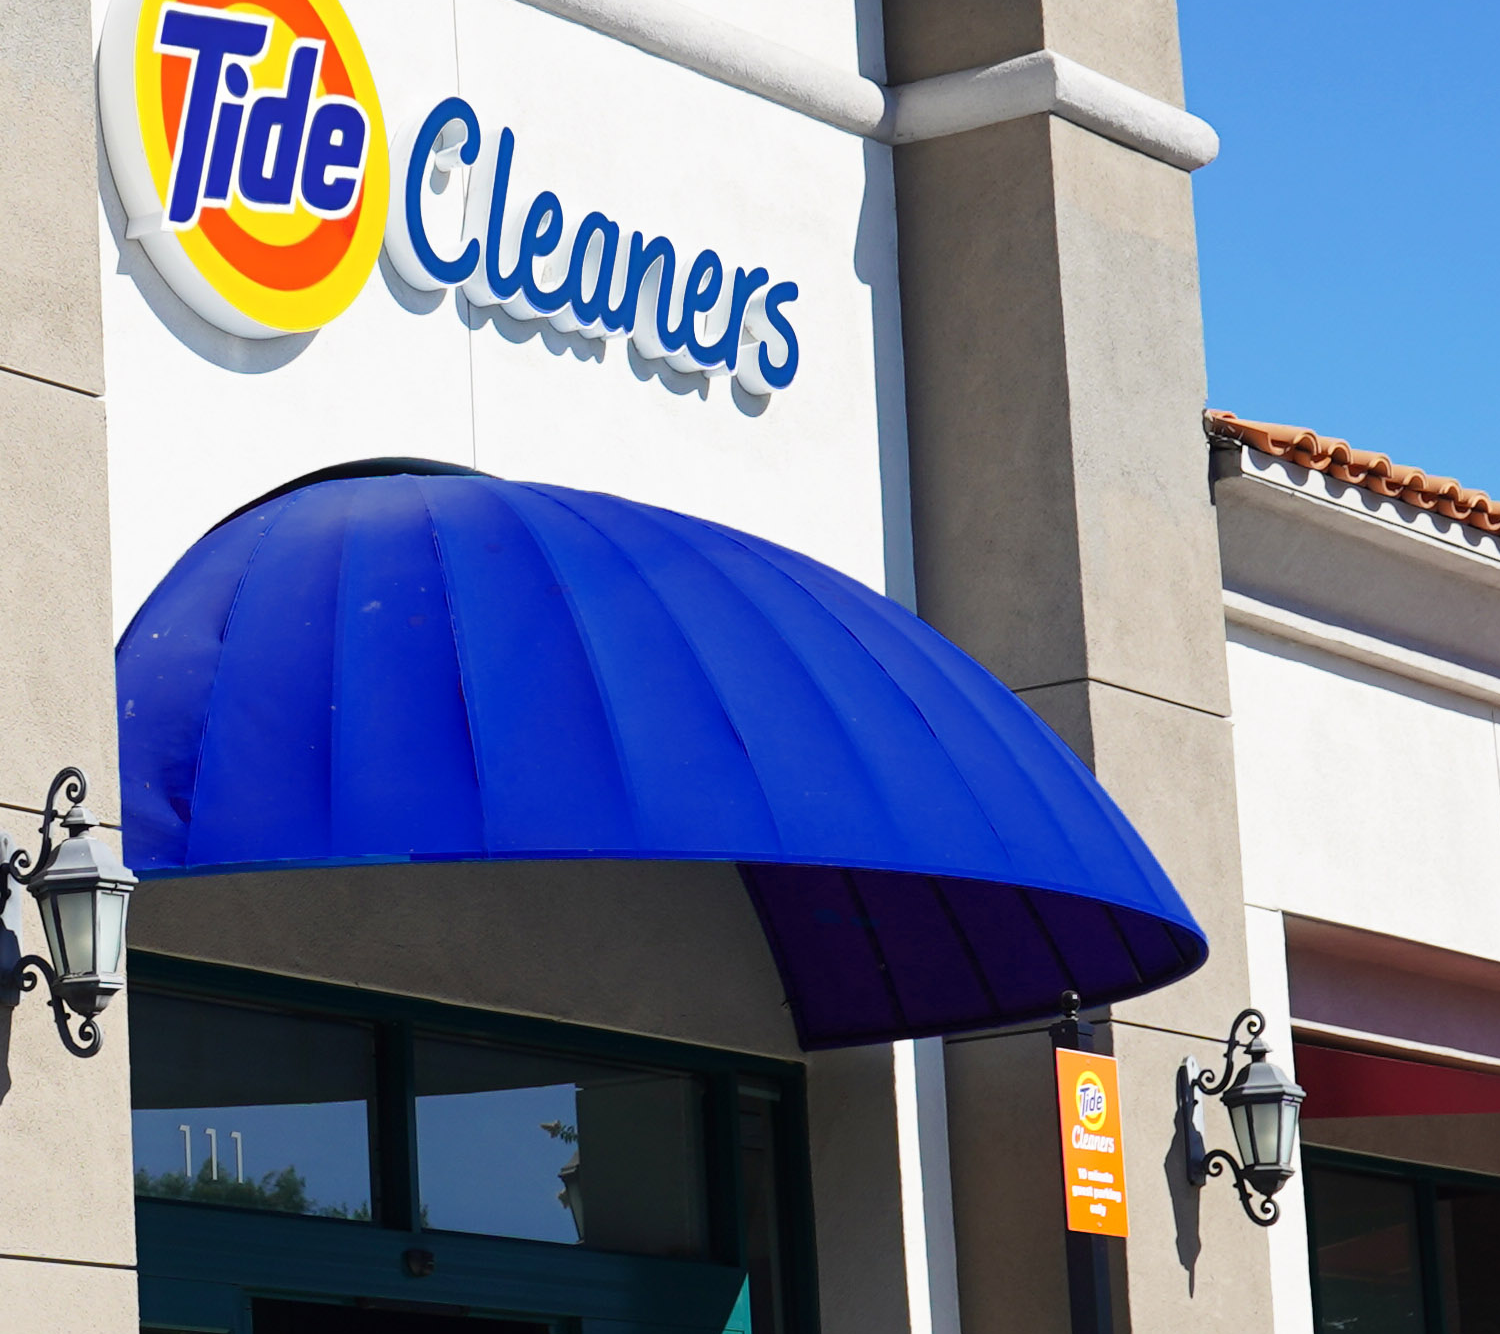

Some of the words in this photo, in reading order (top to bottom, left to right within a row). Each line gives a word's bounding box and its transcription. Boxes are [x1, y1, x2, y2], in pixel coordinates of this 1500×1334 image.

[155, 1, 370, 232] Tide
[406, 96, 799, 391] Cleaners
[1079, 1083, 1103, 1121] Tide
[179, 1124, 243, 1184] 111
[1072, 1125, 1115, 1154] Cleaners
